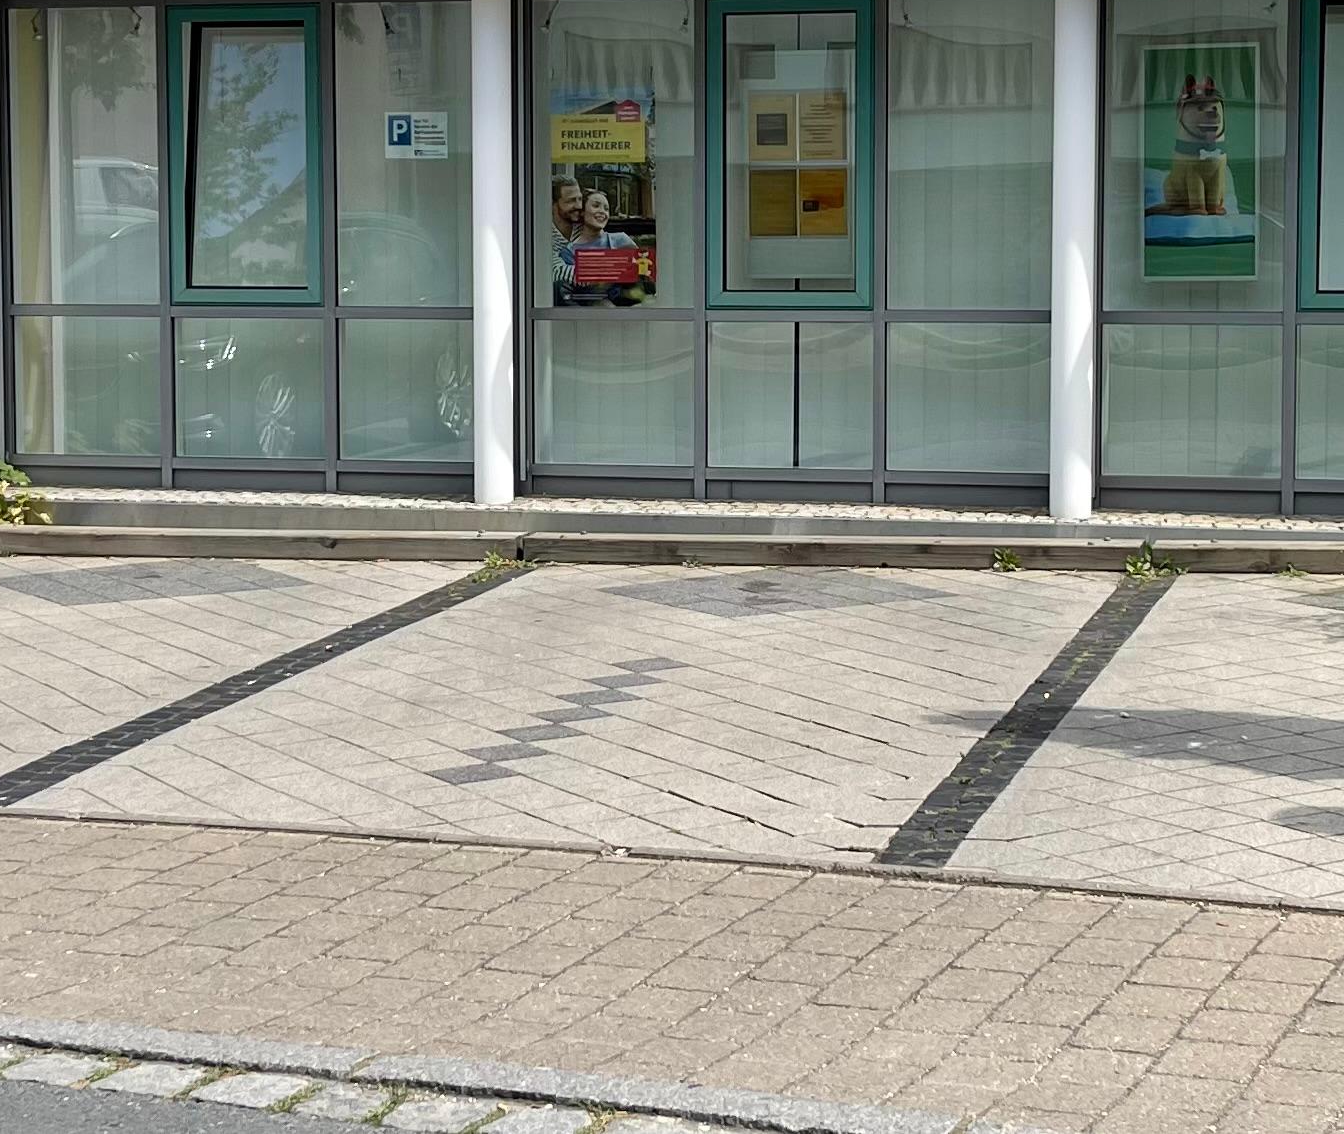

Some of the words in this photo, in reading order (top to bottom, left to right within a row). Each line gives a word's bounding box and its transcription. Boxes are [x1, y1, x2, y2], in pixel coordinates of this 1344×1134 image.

[392, 119, 408, 142] P
[561, 129, 613, 139] FREIHEIT-
[561, 141, 631, 150] FINANZIERER
